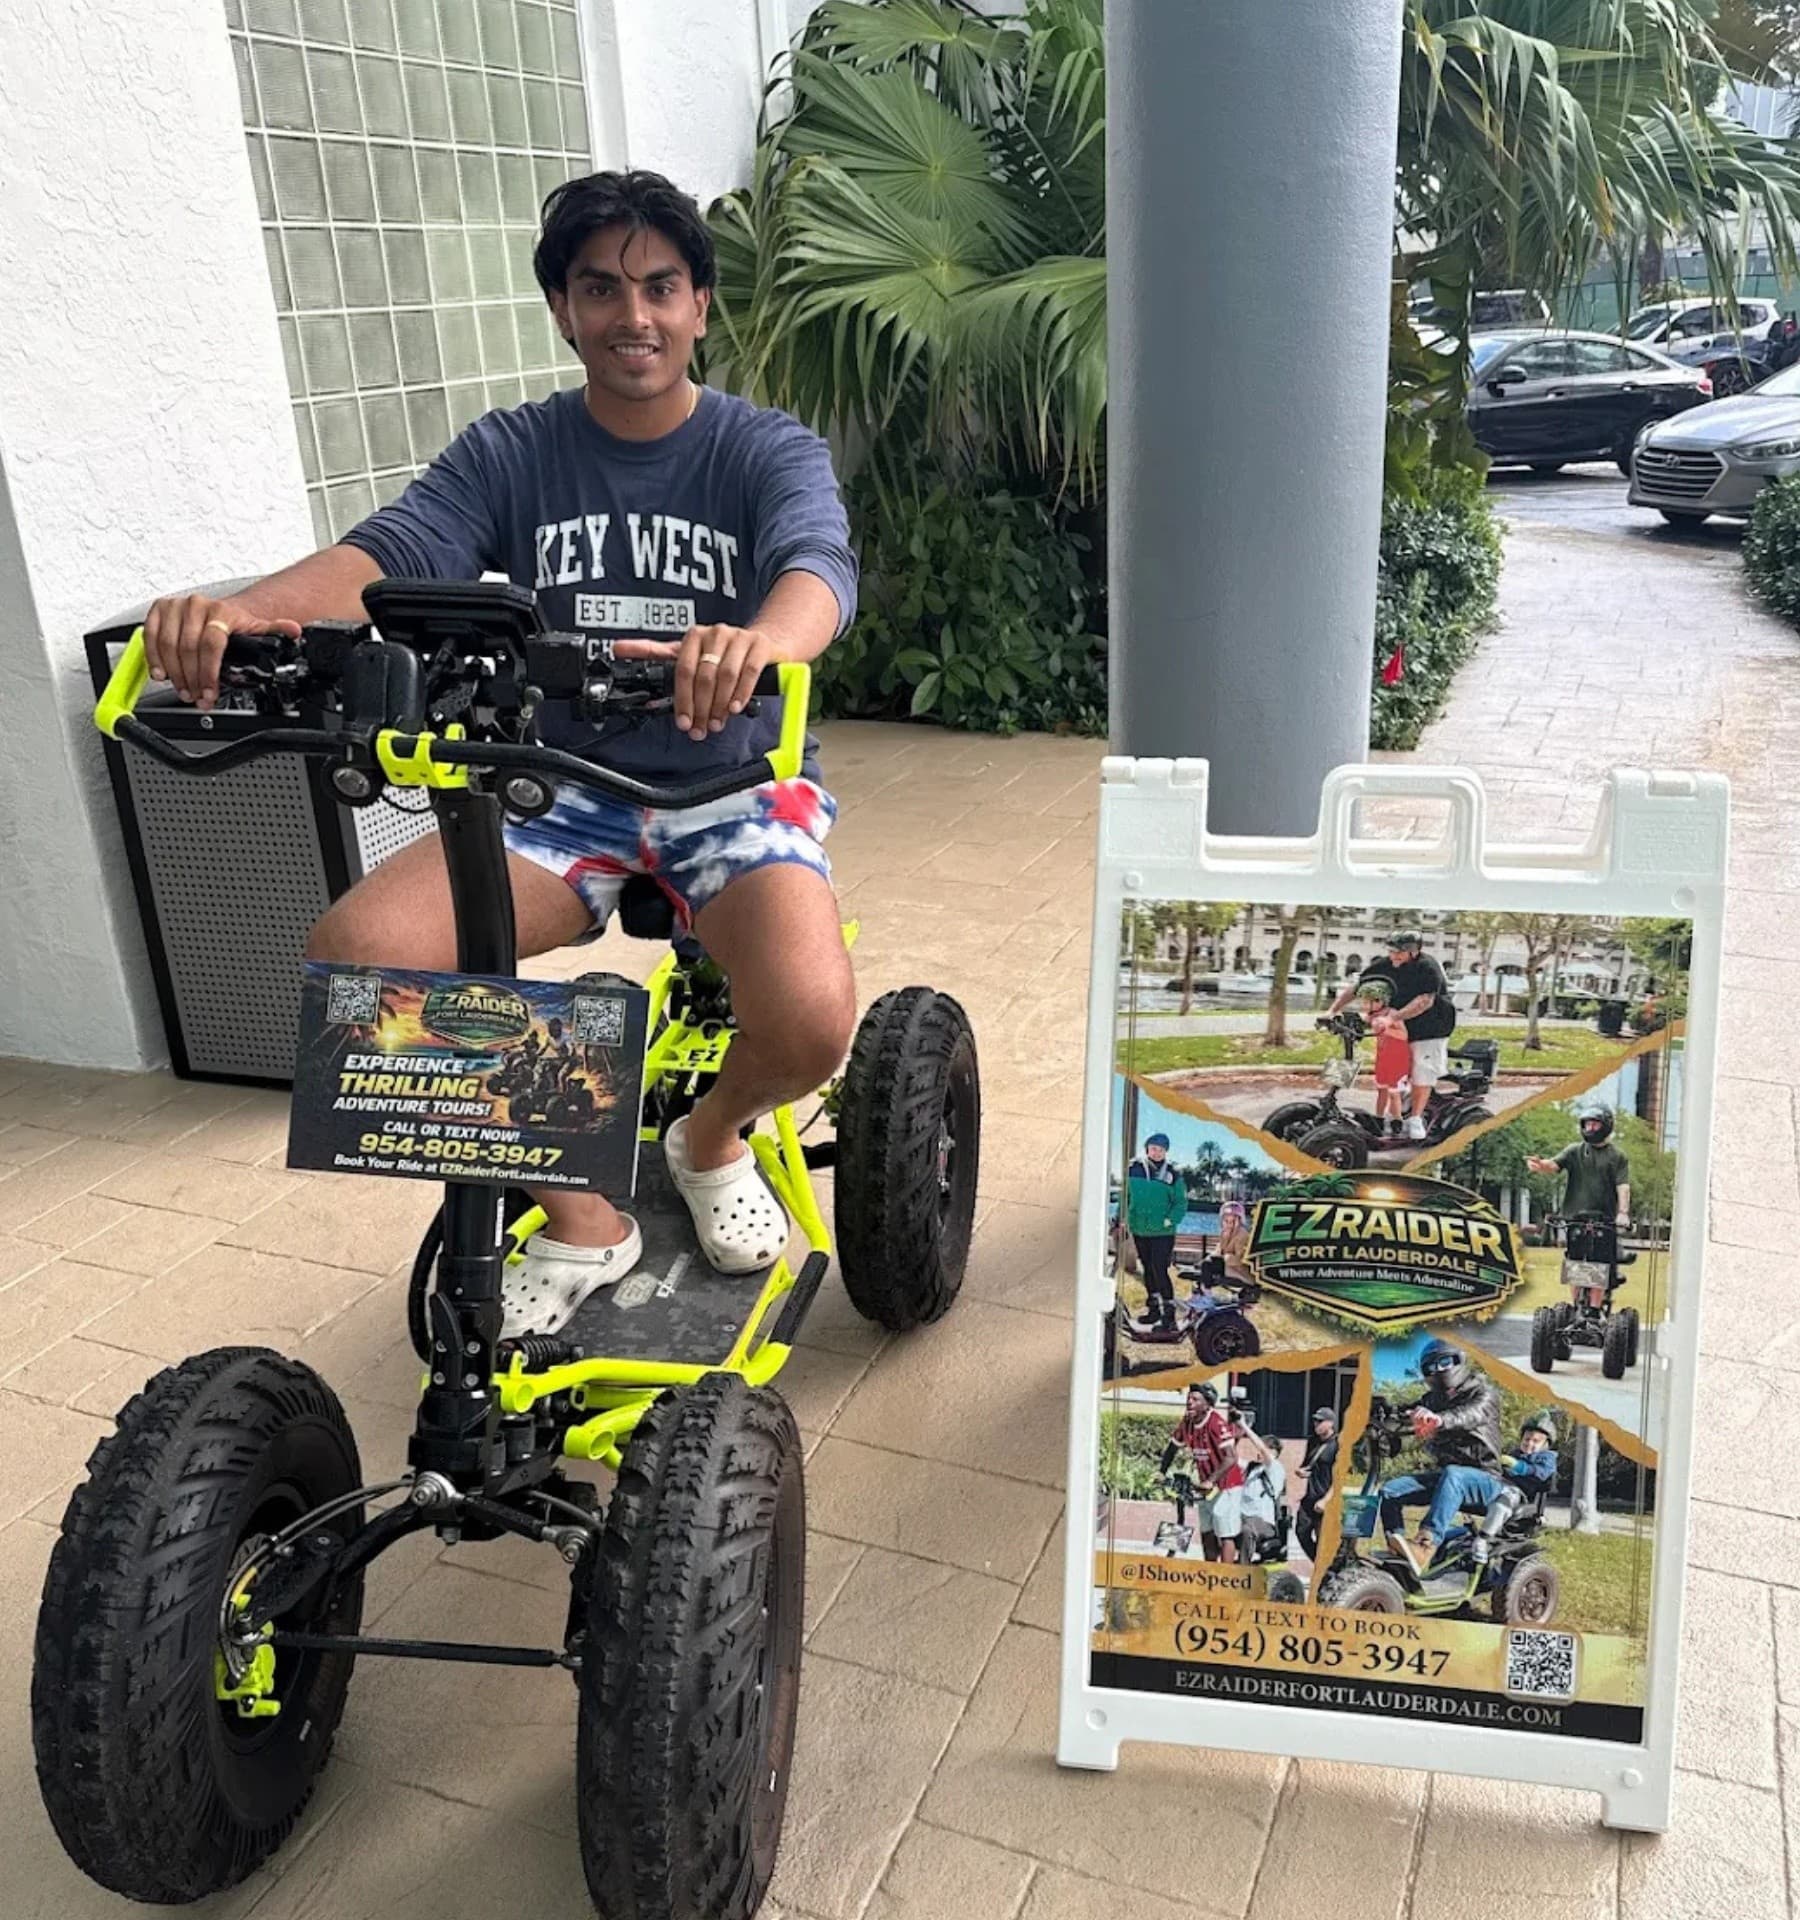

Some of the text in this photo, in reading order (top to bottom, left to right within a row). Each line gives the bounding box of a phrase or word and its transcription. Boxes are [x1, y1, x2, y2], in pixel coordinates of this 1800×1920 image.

[535, 513, 738, 599] KEY WEST
[644, 602, 689, 626] 1828
[426, 992, 528, 1020] EZRAIDER
[344, 1054, 466, 1075] EXPERIENCE
[687, 1049, 719, 1062] EZ
[338, 1073, 480, 1099] THRILLING
[332, 1097, 492, 1116] ADVENTURE TOURS!
[383, 1121, 520, 1143] CALL OR TEXT NOW!
[359, 1133, 563, 1167] 954-805-3947
[334, 1154, 590, 1185] Book Your Ride at EZRaiderFortLauderdale.com
[1257, 1203, 1509, 1264] EZRAIDER
[1285, 1246, 1478, 1275] FORT LAUDERDALE
[1278, 1267, 1476, 1294] Where Adventure Meets Adrenaline
[1120, 1563, 1252, 1590] @IShowSpeed
[1173, 1601, 1230, 1621] CALL
[1250, 1609, 1310, 1629] TEXT
[1315, 1614, 1347, 1633] TO
[1355, 1619, 1421, 1640] BOOK
[1175, 1619, 1451, 1678] (954) 805-3947
[1175, 1670, 1562, 1726] EZRAIDERFORTLAUDERDALE.COM
